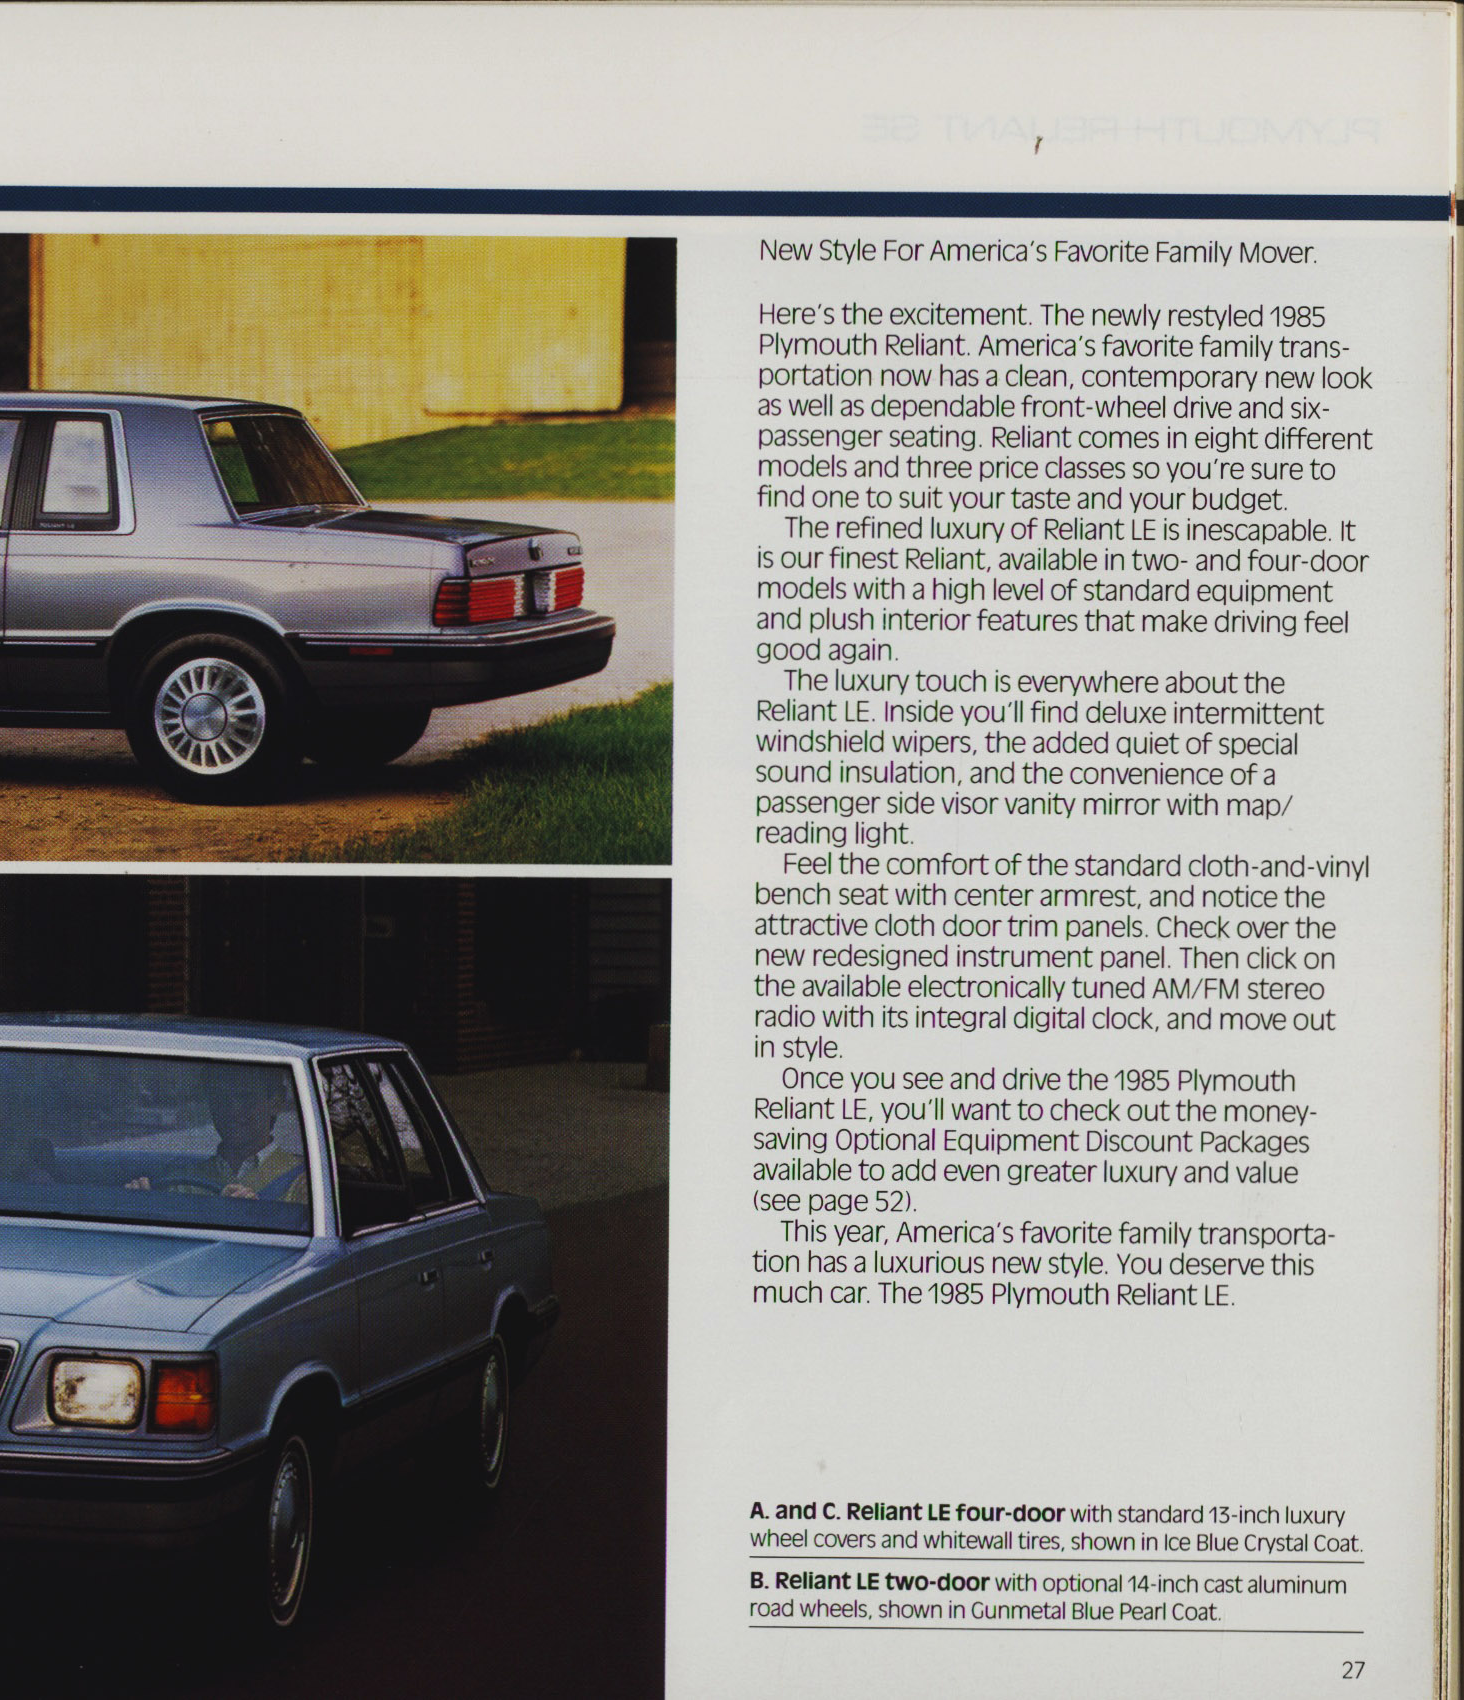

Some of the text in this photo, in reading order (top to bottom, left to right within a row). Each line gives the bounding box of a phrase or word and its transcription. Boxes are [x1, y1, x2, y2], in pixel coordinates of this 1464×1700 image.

[760, 237, 1317, 268] New Style For America's Favorite Family Mover.
[759, 301, 1326, 331] Here's the excitement. The newly restyled 1985
[758, 362, 1373, 393] portation now has a clean, contemporary new look
[758, 424, 1374, 454] passenger seating. Reliant comes in eight different
[784, 515, 1357, 546] The refined luxury of Reliant LE is inescapable. It
[783, 667, 1286, 697] The luxury touch is everywhere about the
[755, 728, 1298, 759] windshield wipers, the added quiet of special
[783, 851, 1370, 882] Feel the comfort of the standard cloth-and-vinyl
[754, 912, 1337, 942] attractive cloth door trim panels. Check over the
[753, 973, 1325, 1003] the available electronically tuned AM/FM stereo
[781, 1066, 1296, 1096] Once you see and drive the 1985 Plymouth
[753, 1126, 1310, 1158] saving Optional Equipment Discount Packages
[780, 1218, 1336, 1250] This year, America's favorite family transporta-
[753, 1279, 1235, 1309] much car. The 1985 Plymouth Reliant LE.
[749, 1501, 1346, 1528] A. and C. Reliant LE four-door with standard 13-inch luxury
[749, 1528, 1364, 1555] wheel covers and whitewall tires, shown in Ice Blue Crystal Coat.
[750, 1570, 1347, 1596] B. Reliant LE two-door with optional 14-inch cast aluminum
[749, 1598, 1222, 1622] road wheels, shown in Gunmetal Blue Pearl Coat.
[1342, 1660, 1366, 1680] 27
